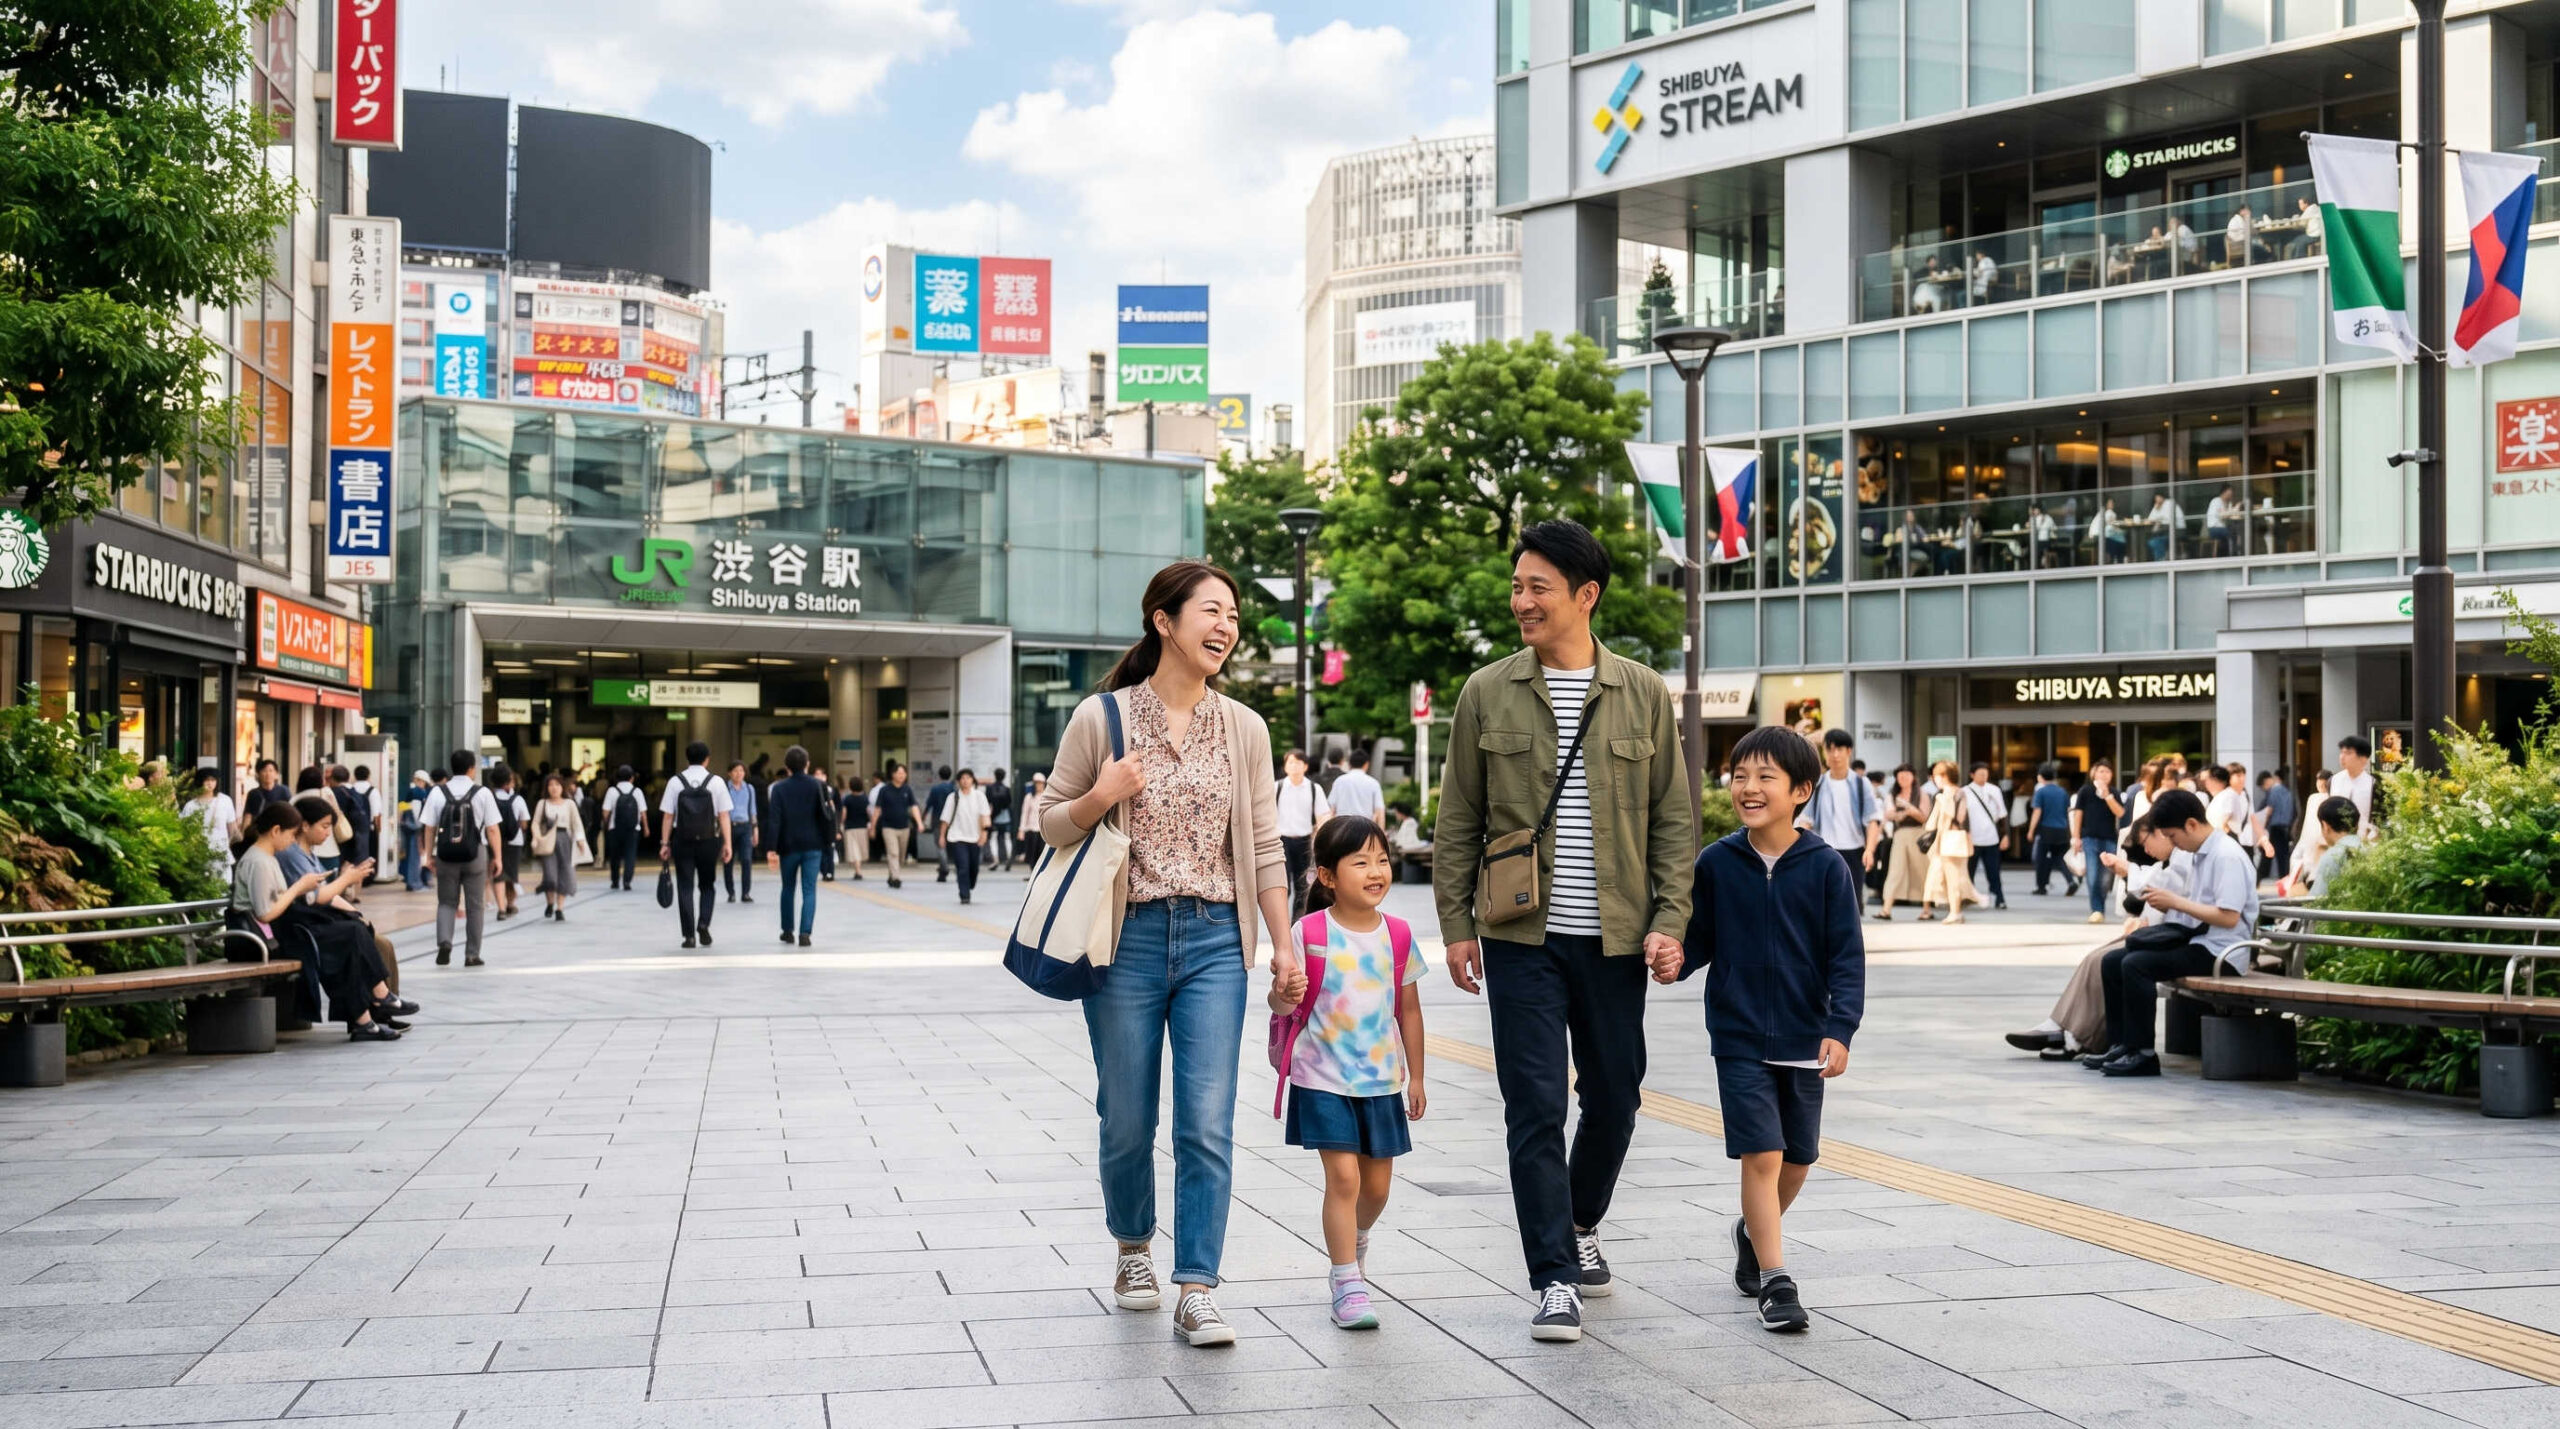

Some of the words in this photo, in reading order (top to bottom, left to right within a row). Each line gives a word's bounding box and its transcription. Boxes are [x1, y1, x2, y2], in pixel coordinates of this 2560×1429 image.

[1660, 61, 1745, 97] SHIBUYA
[1660, 73, 1804, 138] STREAM
[2132, 136, 2237, 168] STARHUCKS
[348, 329, 376, 442] レストラン
[337, 458, 384, 549] 書店
[2491, 477, 2560, 497] 東急スト
[95, 542, 212, 613] STARRUCKS
[612, 537, 695, 587] JR
[711, 539, 862, 588] 渋谷駅
[711, 587, 789, 613] Shibuya
[795, 592, 861, 613] Station
[627, 684, 649, 699] JR
[2016, 677, 2113, 701] SHIBUYA
[2118, 673, 2215, 698] STREAM
